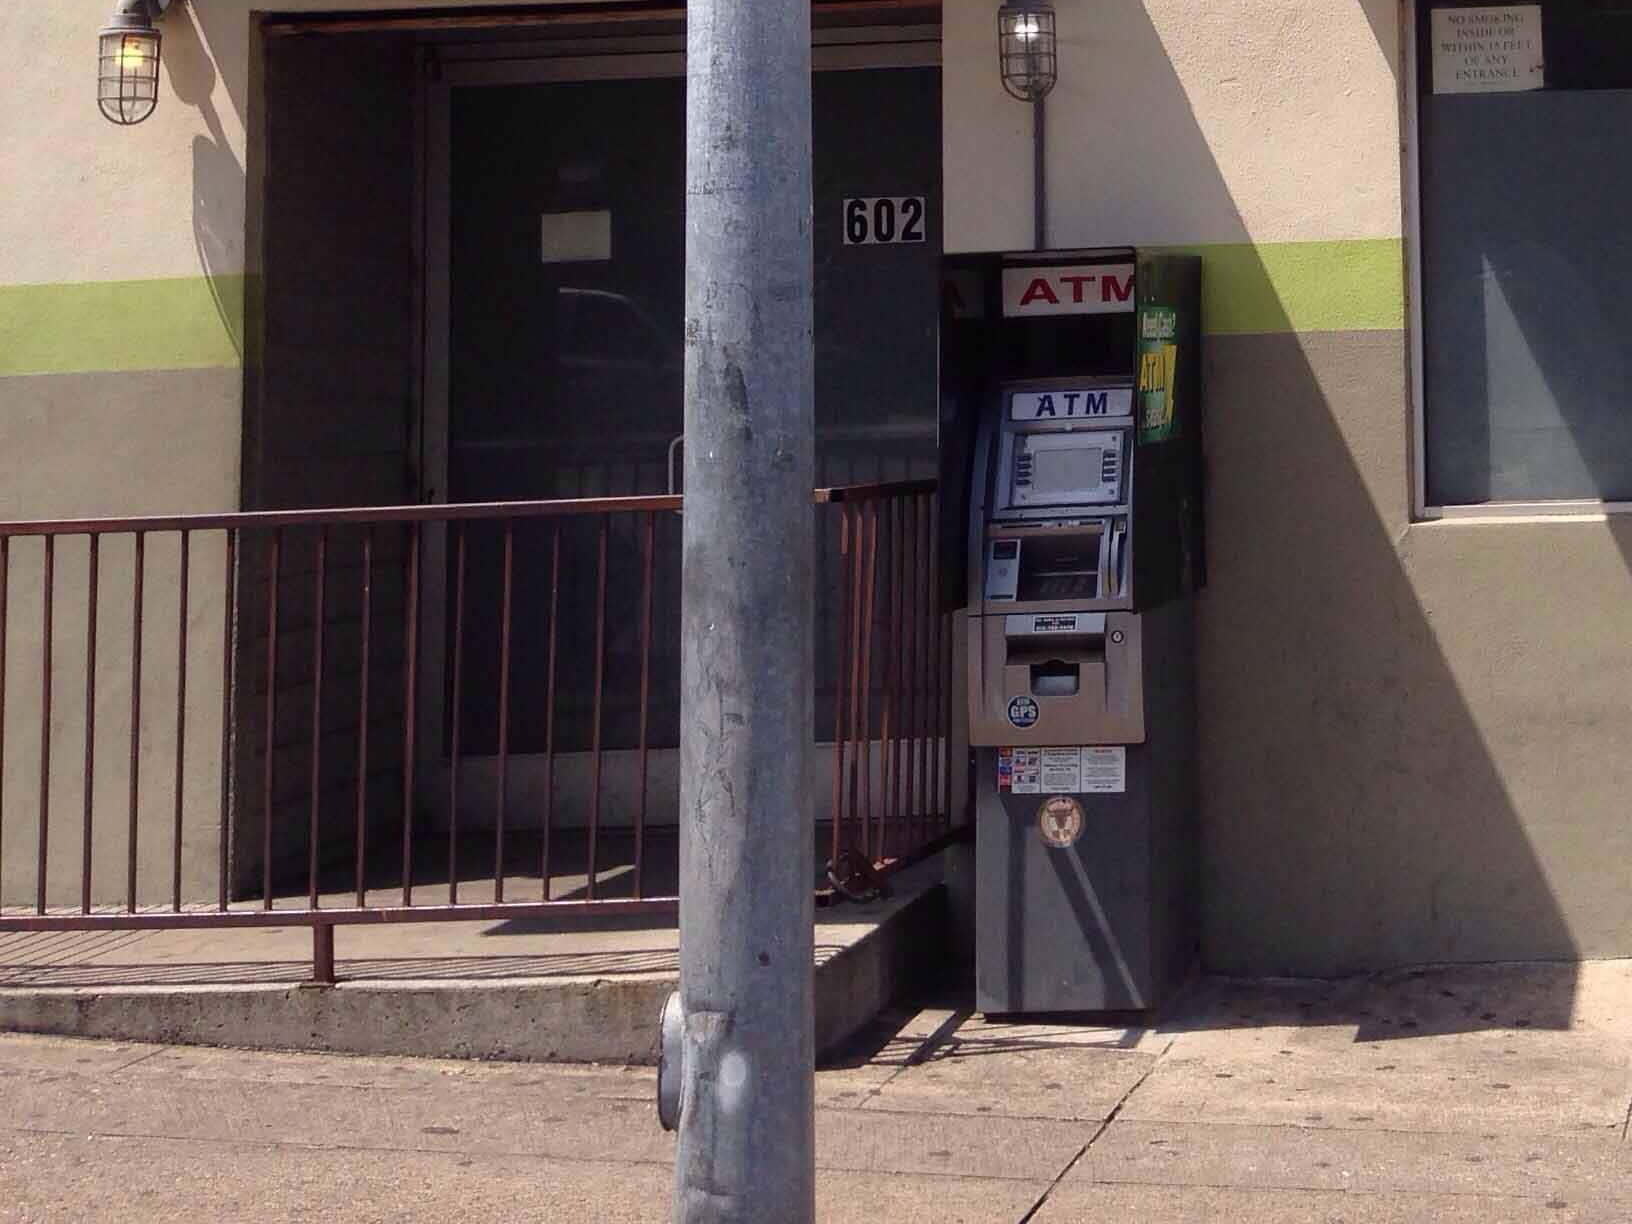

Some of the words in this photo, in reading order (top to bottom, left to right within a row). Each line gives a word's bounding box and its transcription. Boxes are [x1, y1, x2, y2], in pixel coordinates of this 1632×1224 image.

[846, 197, 923, 244] 602
[1019, 275, 1137, 306] ATM
[1035, 391, 1108, 417] ATM
[1010, 704, 1037, 719] GPS
